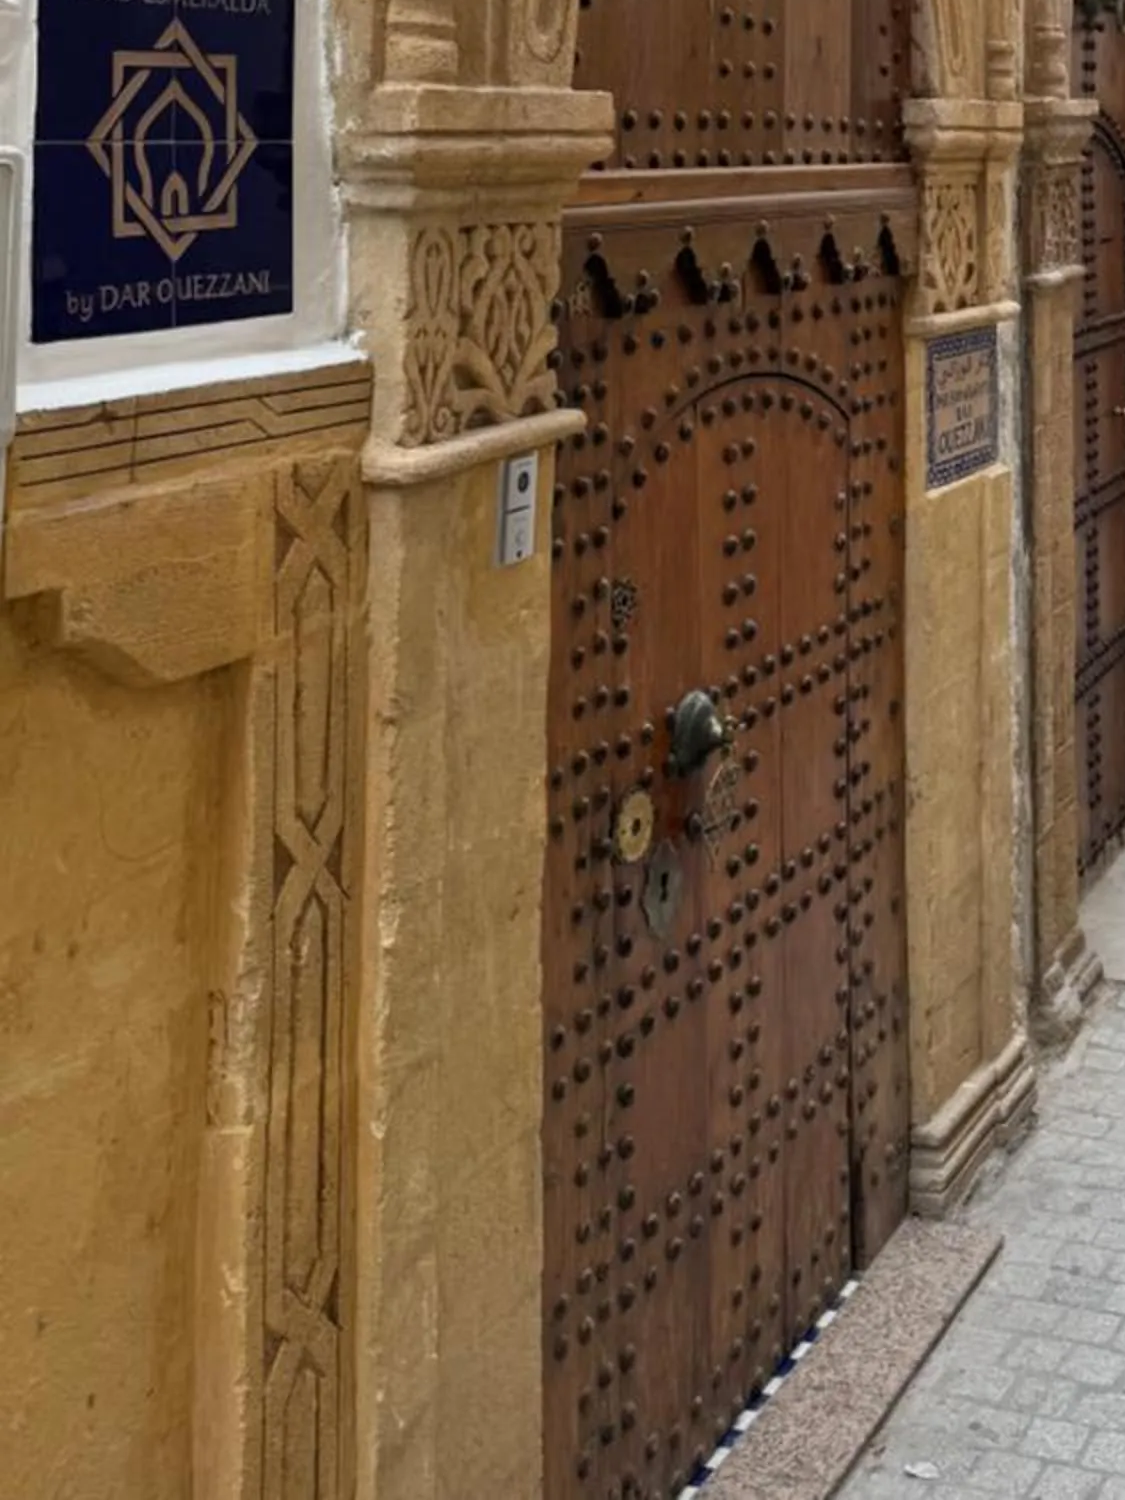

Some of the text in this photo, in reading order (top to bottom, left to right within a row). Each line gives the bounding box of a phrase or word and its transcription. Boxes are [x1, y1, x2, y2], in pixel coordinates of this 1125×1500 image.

[66, 269, 271, 321] by DAR OUEZZANI
